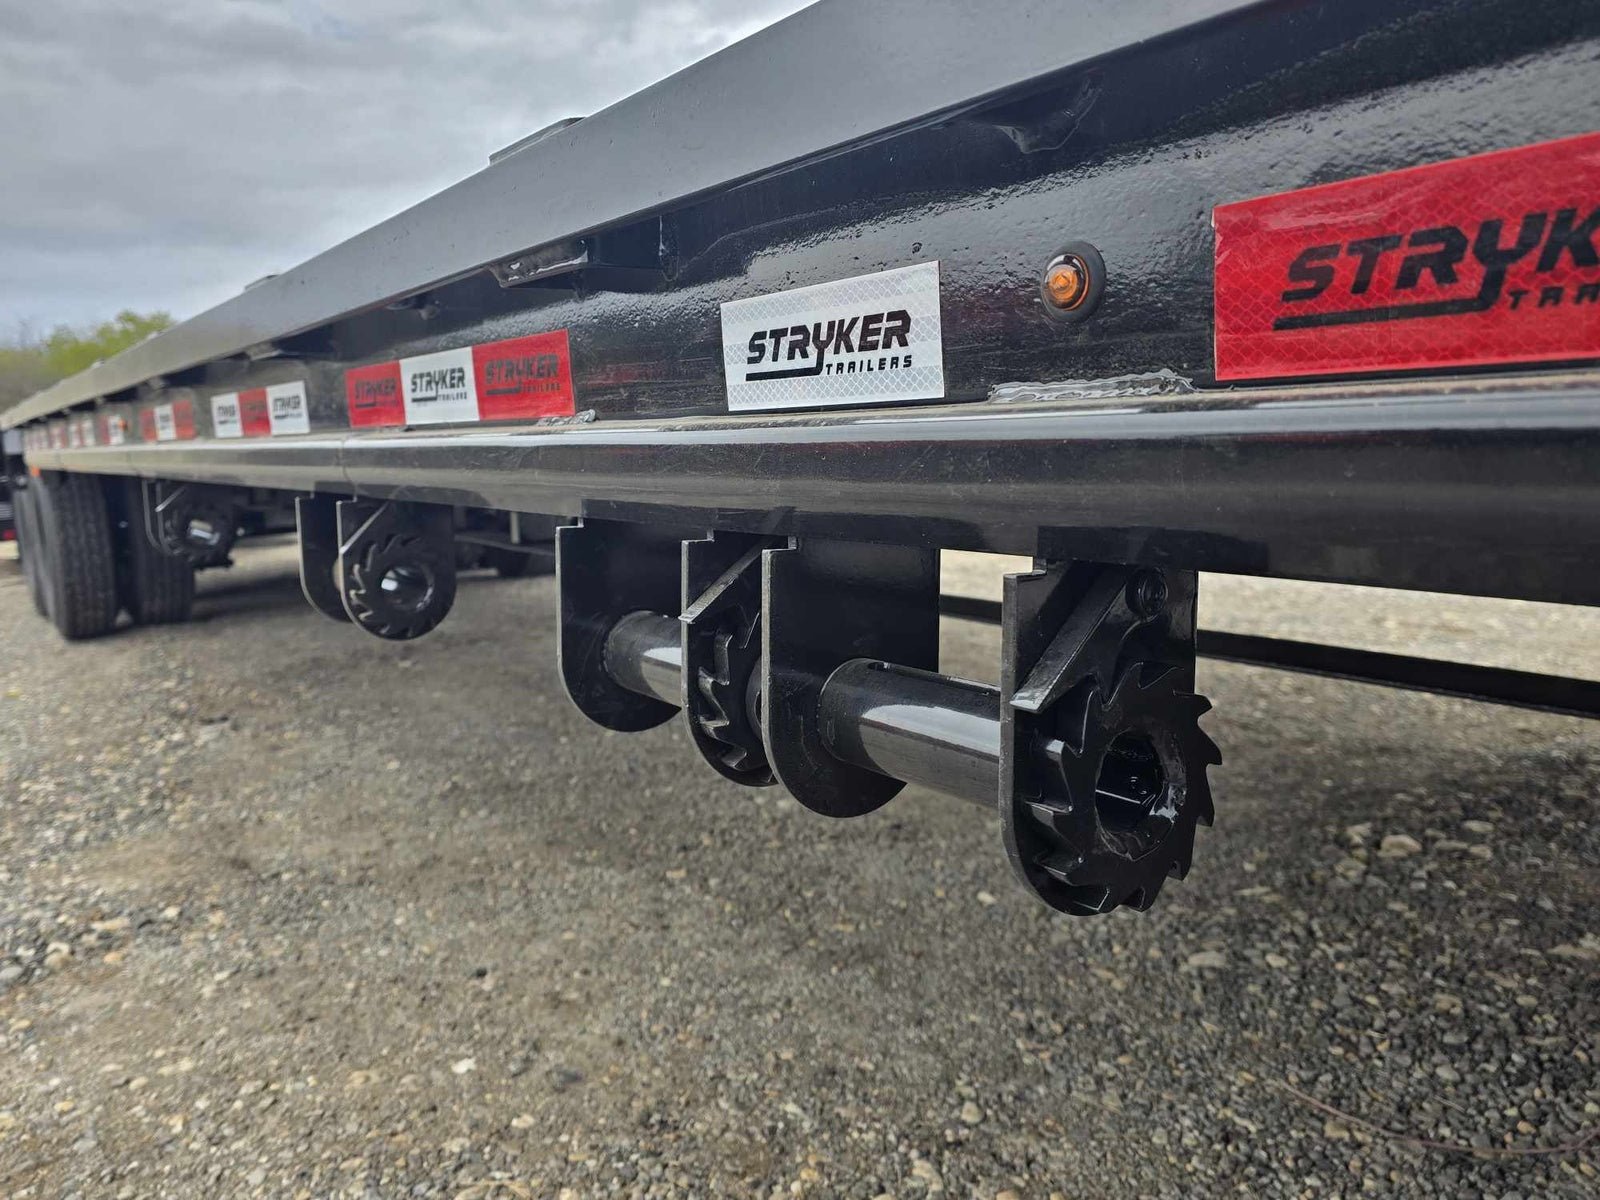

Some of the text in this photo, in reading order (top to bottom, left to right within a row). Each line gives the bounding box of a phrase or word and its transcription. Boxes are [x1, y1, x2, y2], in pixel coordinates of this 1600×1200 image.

[746, 309, 912, 382] STRYKER
[826, 354, 912, 376] TRAILERS
[411, 367, 466, 403] STRYKER
[485, 353, 559, 396] STRYKER
